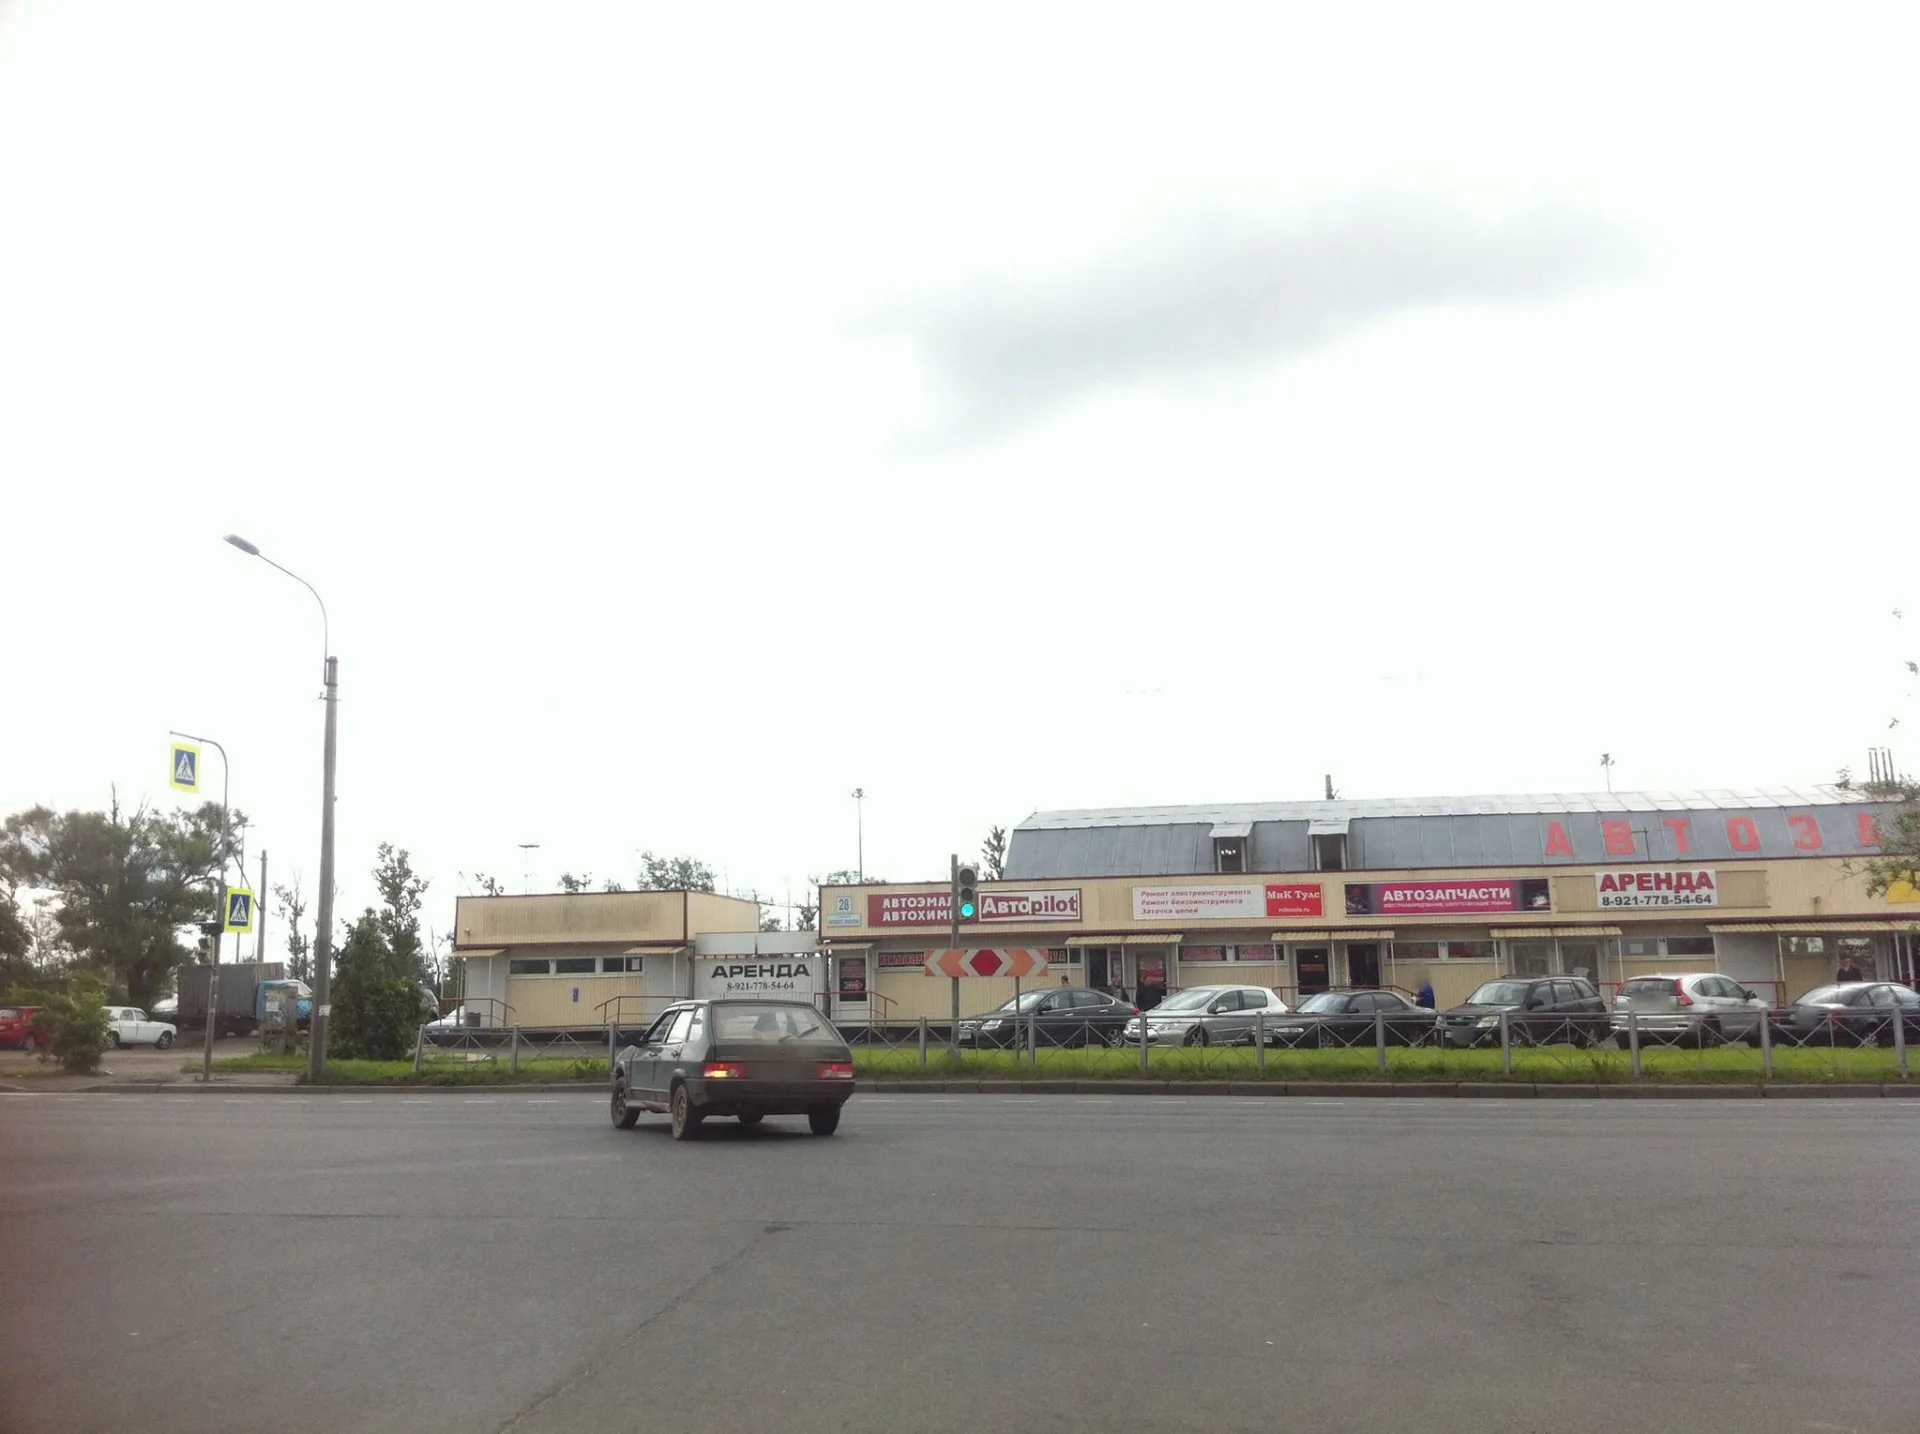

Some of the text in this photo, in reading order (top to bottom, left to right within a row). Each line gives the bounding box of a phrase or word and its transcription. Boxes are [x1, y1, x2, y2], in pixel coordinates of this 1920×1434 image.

[1599, 871, 1714, 893] АРЕНДА
[1295, 891, 1320, 901] Тулс
[1383, 887, 1511, 901] АВТОЗАПЧАСТИ
[1601, 894, 1712, 906] 8-921-778-54-64
[838, 898, 850, 911] 28
[711, 964, 811, 978] АРЕНДА
[727, 981, 794, 991] 8-921-778-54-64
